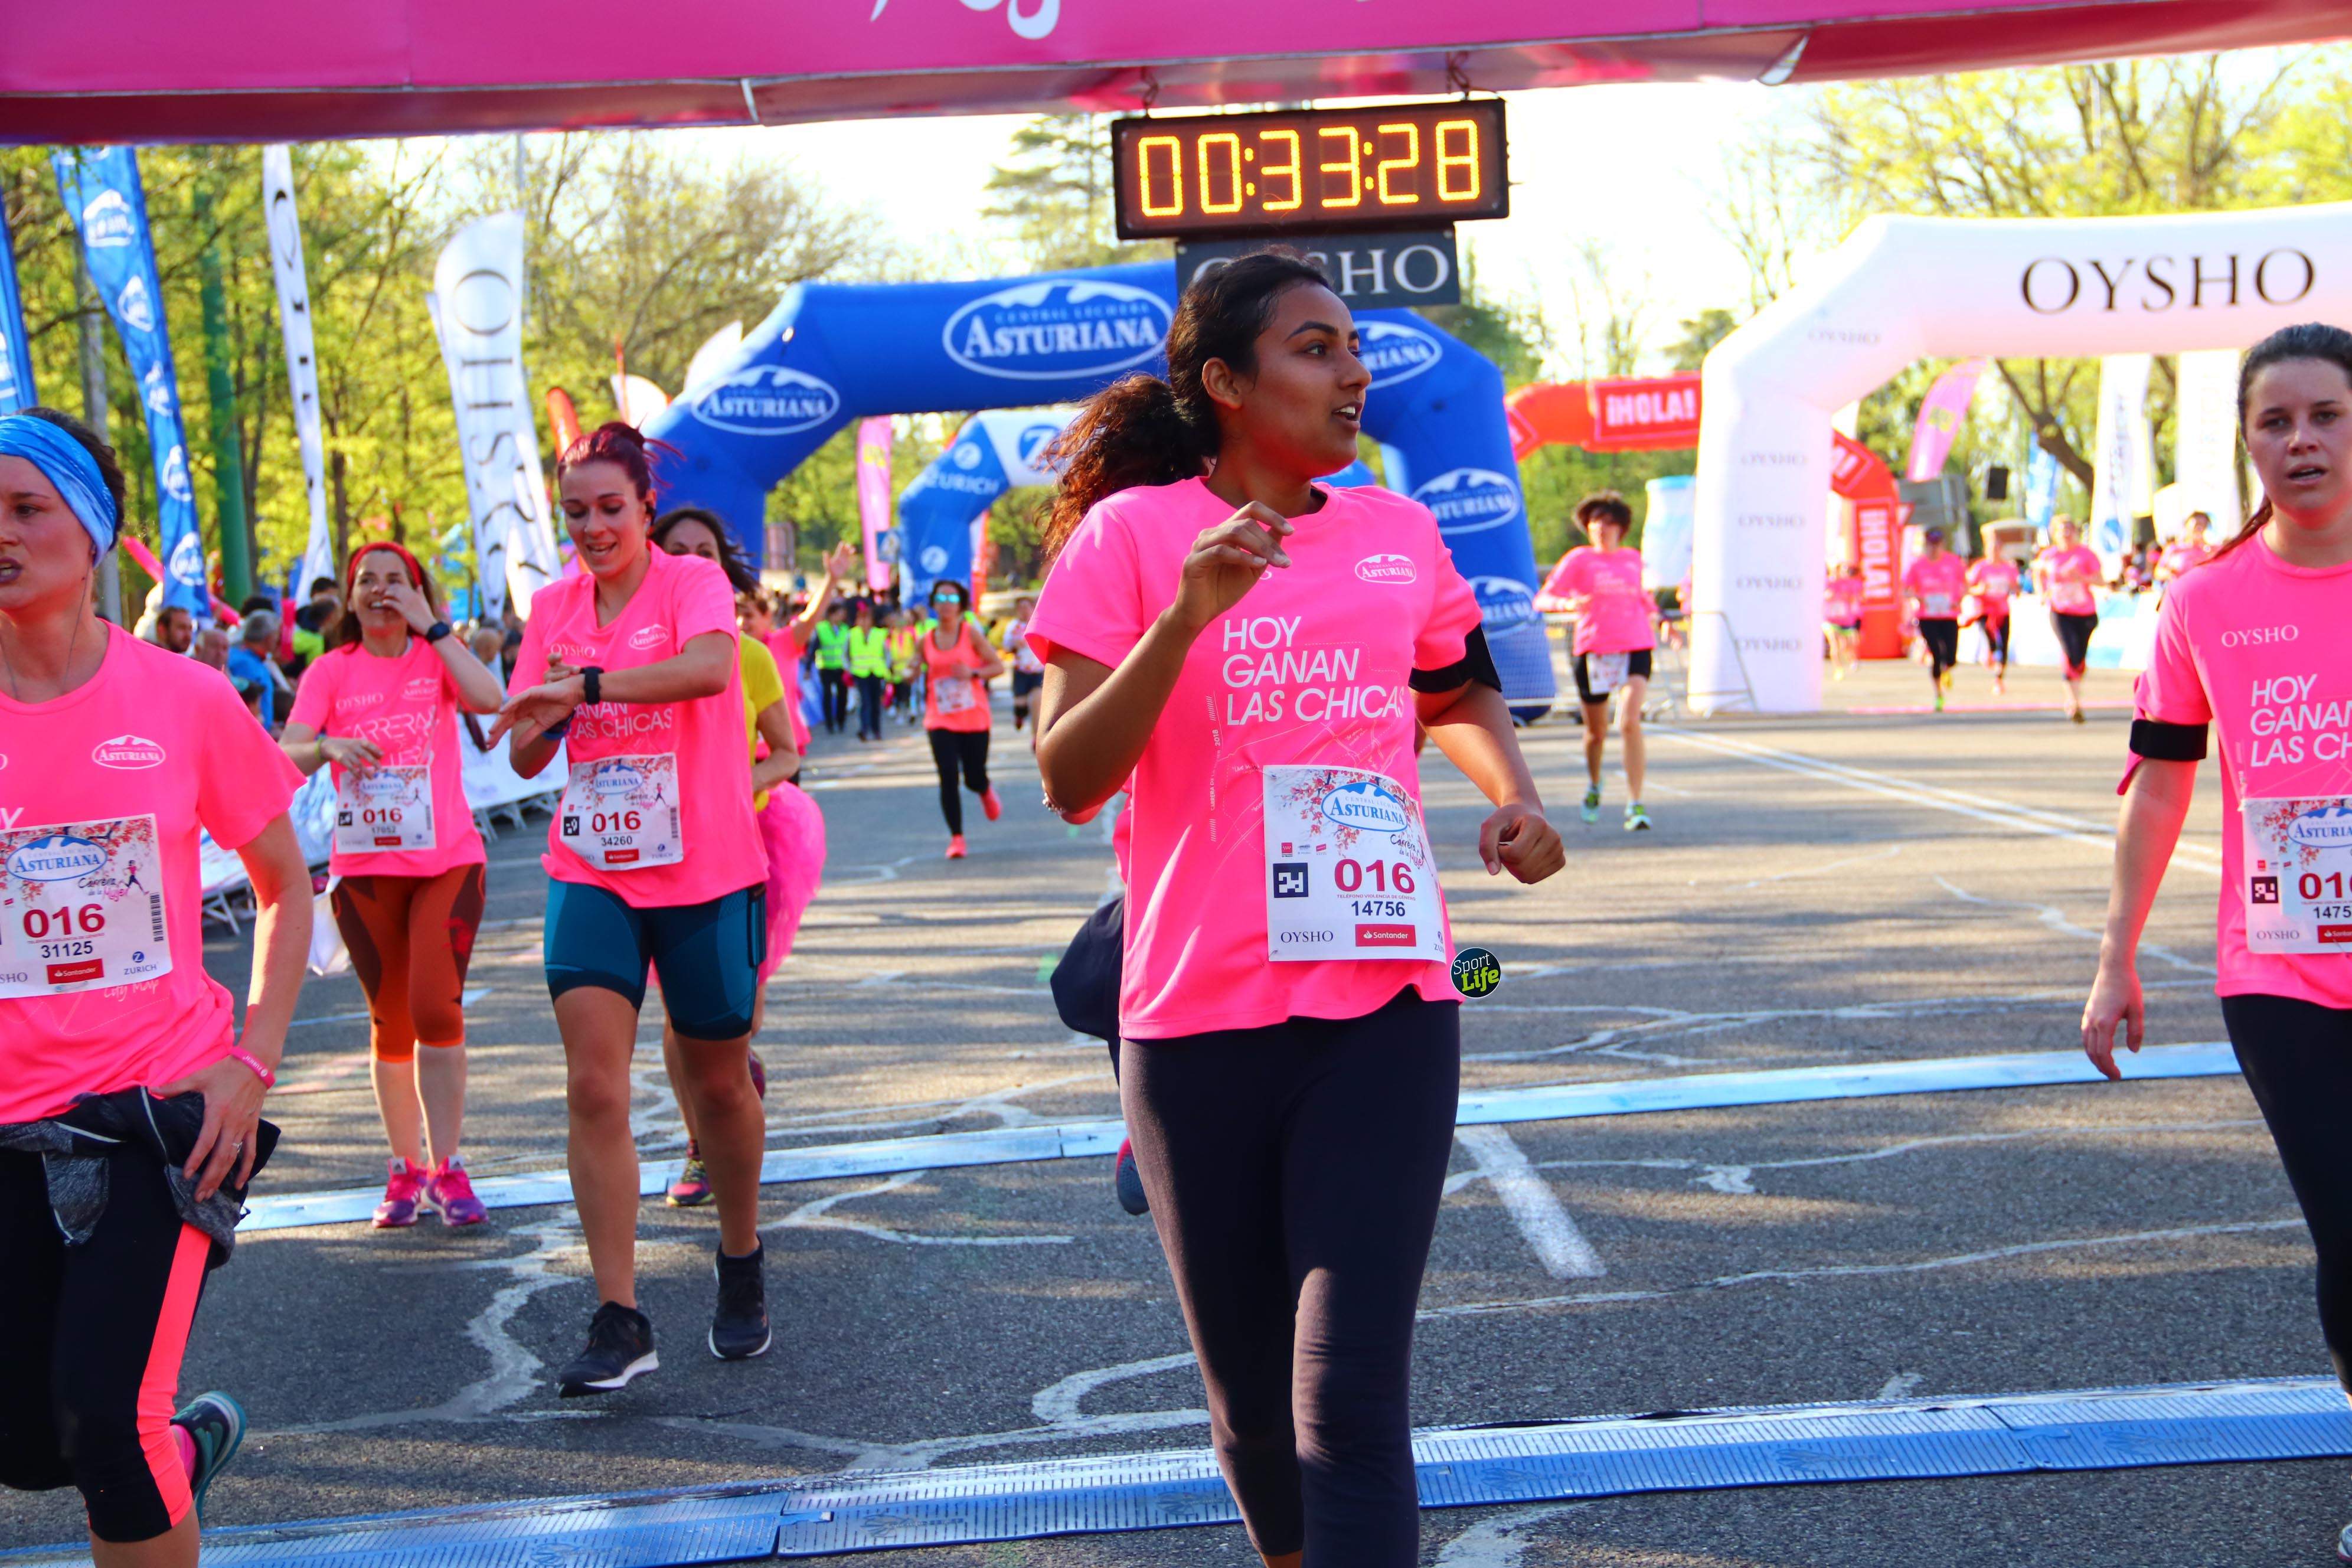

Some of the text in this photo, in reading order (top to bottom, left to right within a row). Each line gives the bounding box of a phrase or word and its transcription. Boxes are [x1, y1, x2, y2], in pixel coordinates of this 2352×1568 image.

[1138, 120, 1479, 217] 00:33:28
[2021, 249, 2315, 314] OYSHO
[962, 315, 1159, 358] ASTURIANA
[1360, 344, 1431, 371] RIANA
[702, 390, 827, 417] ASTURIANA
[1605, 388, 1696, 426] ¡HOLA!
[1429, 494, 1510, 520] STURIANA
[1362, 566, 1413, 578] ASTURIANA
[1223, 616, 1302, 652] HOY
[2222, 625, 2299, 647] OYSHO
[551, 643, 595, 658] OYSHO
[1223, 648, 1359, 688] GANAN
[336, 692, 384, 710] OYSHO
[2251, 674, 2317, 707] HOY
[574, 701, 628, 719] ANAN
[1227, 685, 1404, 726] LAS CHICAS
[601, 708, 672, 737] CHICAS
[1212, 729, 1220, 747] 2018
[2250, 736, 2304, 767] LAS
[362, 808, 403, 824] 016
[592, 811, 641, 832] 016
[1329, 796, 1405, 826] ASTURIANA
[601, 835, 633, 847] 34260
[15, 854, 100, 873] ASTURIANA
[1334, 859, 1415, 894] 016
[2299, 872, 2352, 900] 01
[23, 903, 105, 938] 016
[1351, 900, 1406, 917] 14756
[1280, 930, 1408, 943] OYSHO Santander
[2256, 930, 2300, 940] OYSHO
[41, 940, 93, 959] 31125
[63, 966, 97, 976] Santander
[123, 963, 158, 975] ZURICH
